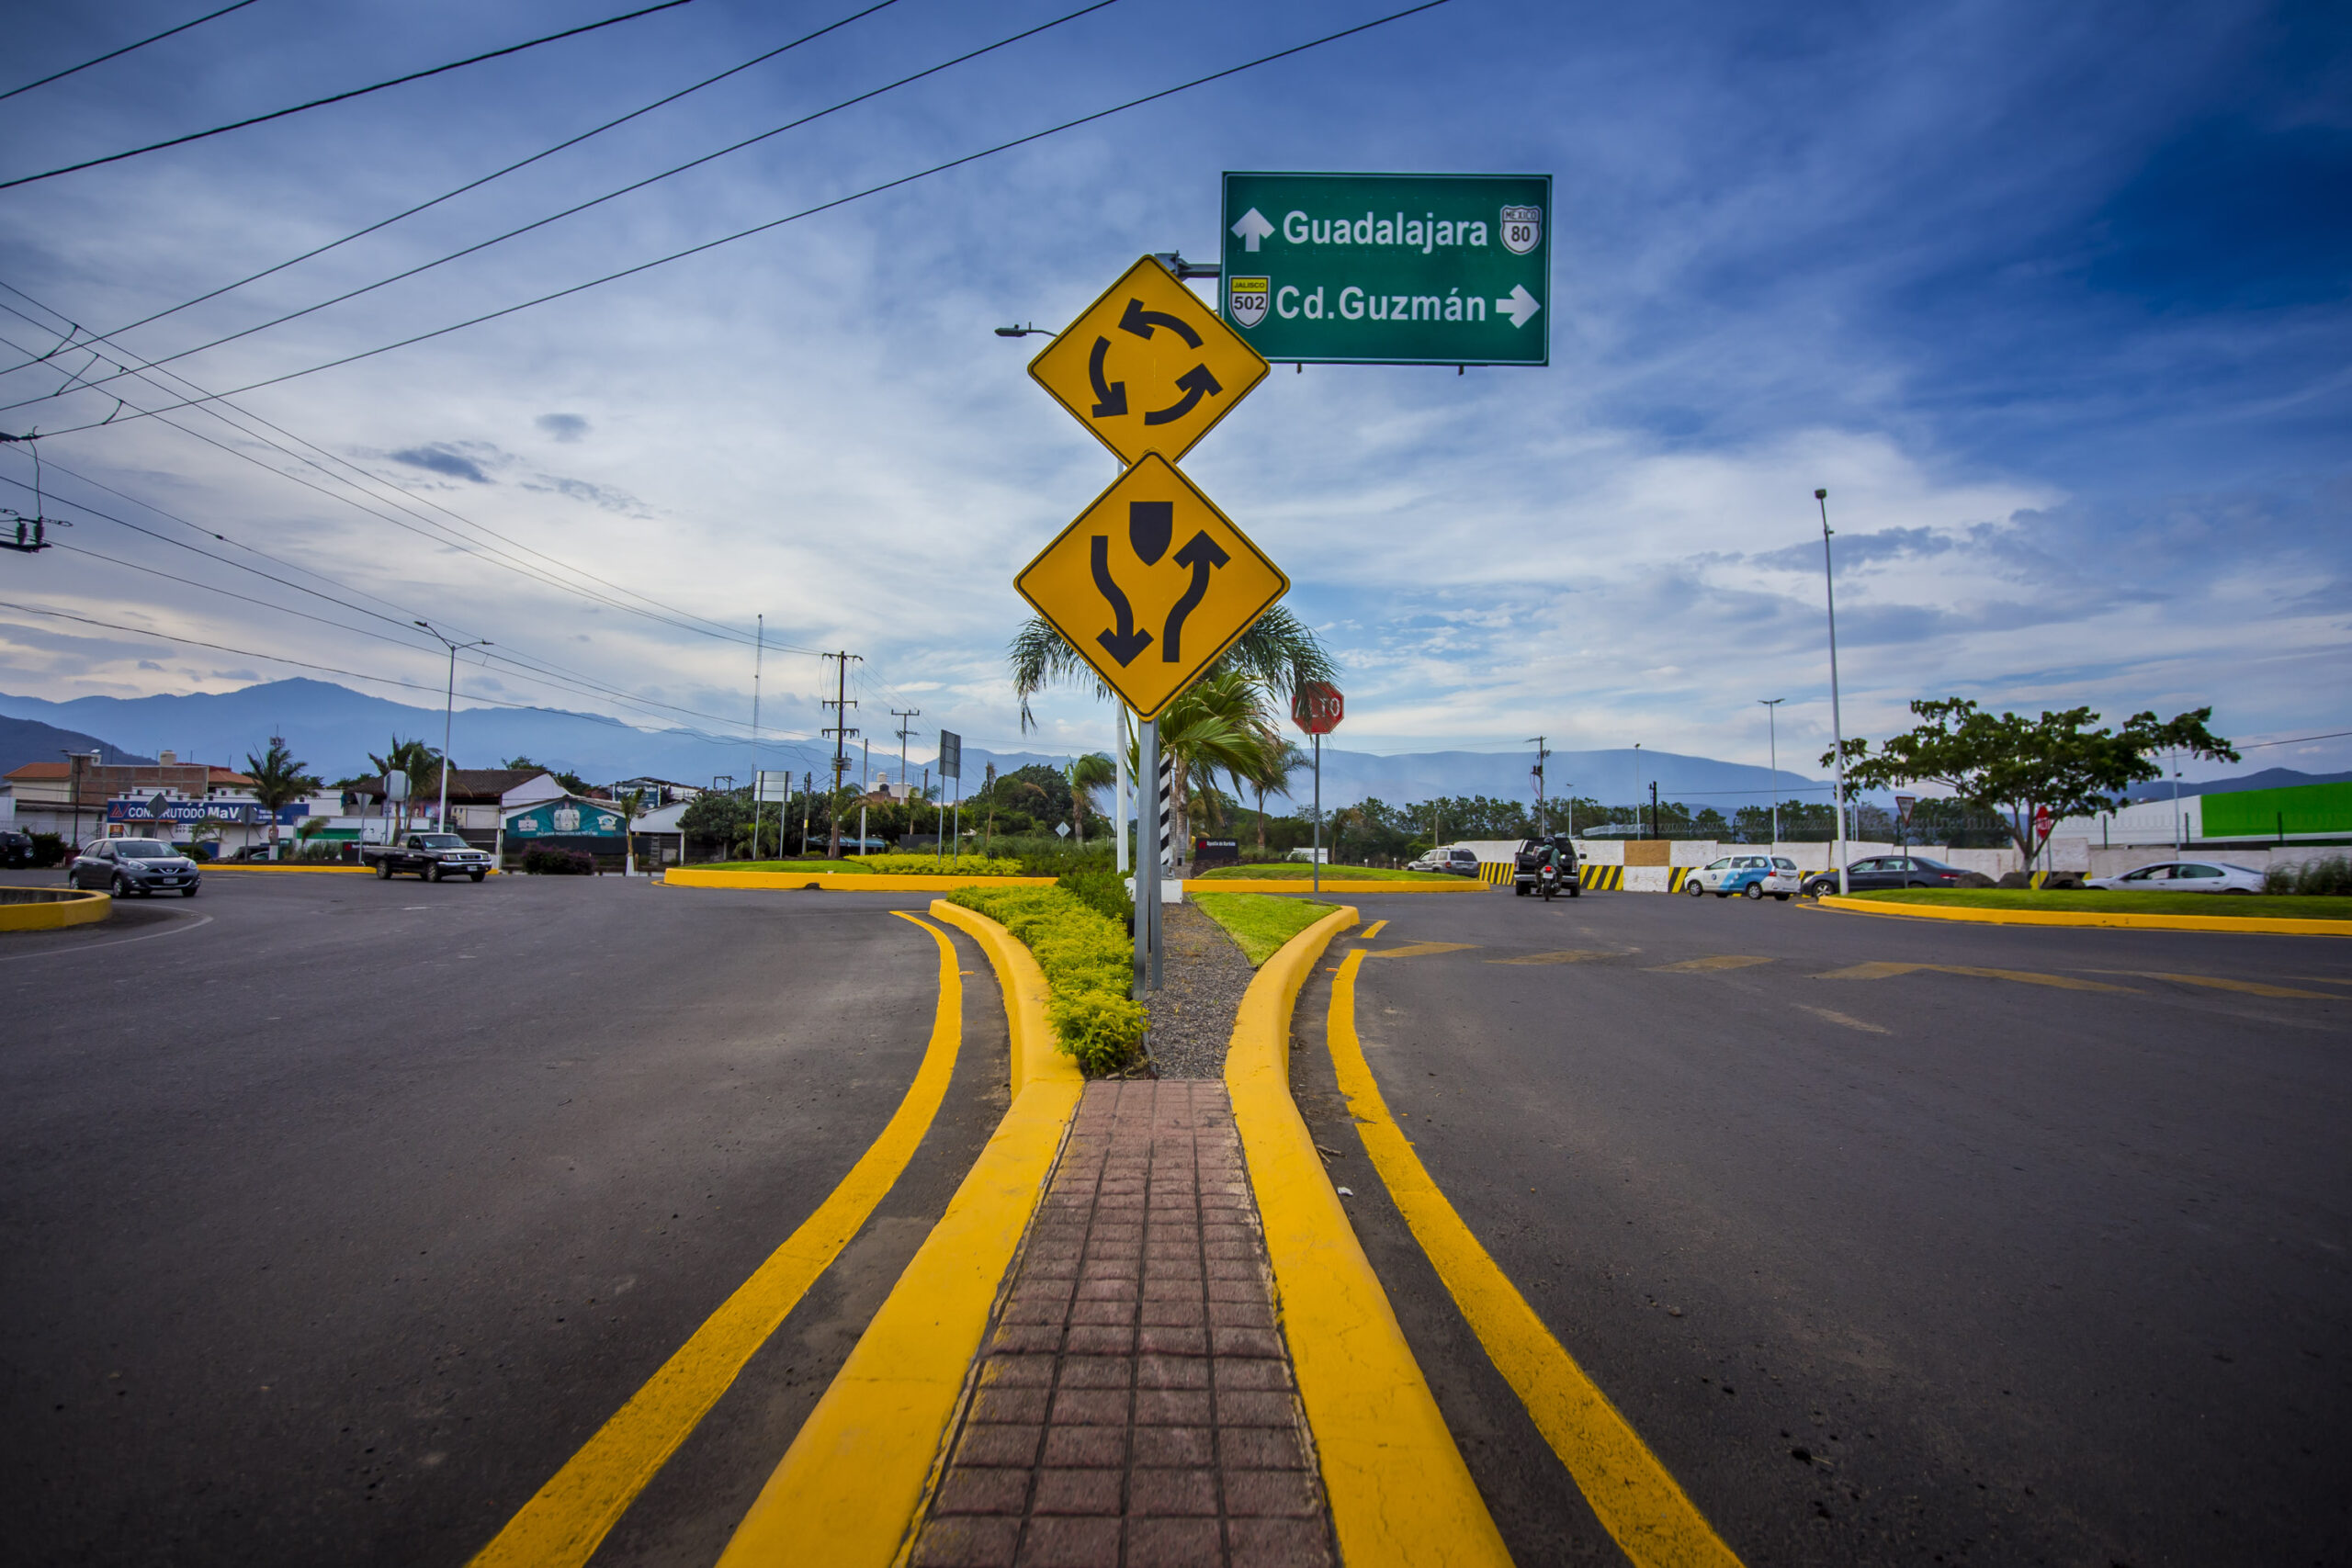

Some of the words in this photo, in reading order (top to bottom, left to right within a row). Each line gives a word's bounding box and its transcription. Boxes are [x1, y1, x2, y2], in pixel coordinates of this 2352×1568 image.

[1283, 210, 1488, 254] Guadalajara
[1511, 225, 1531, 243] 80
[1233, 296, 1265, 310] 502
